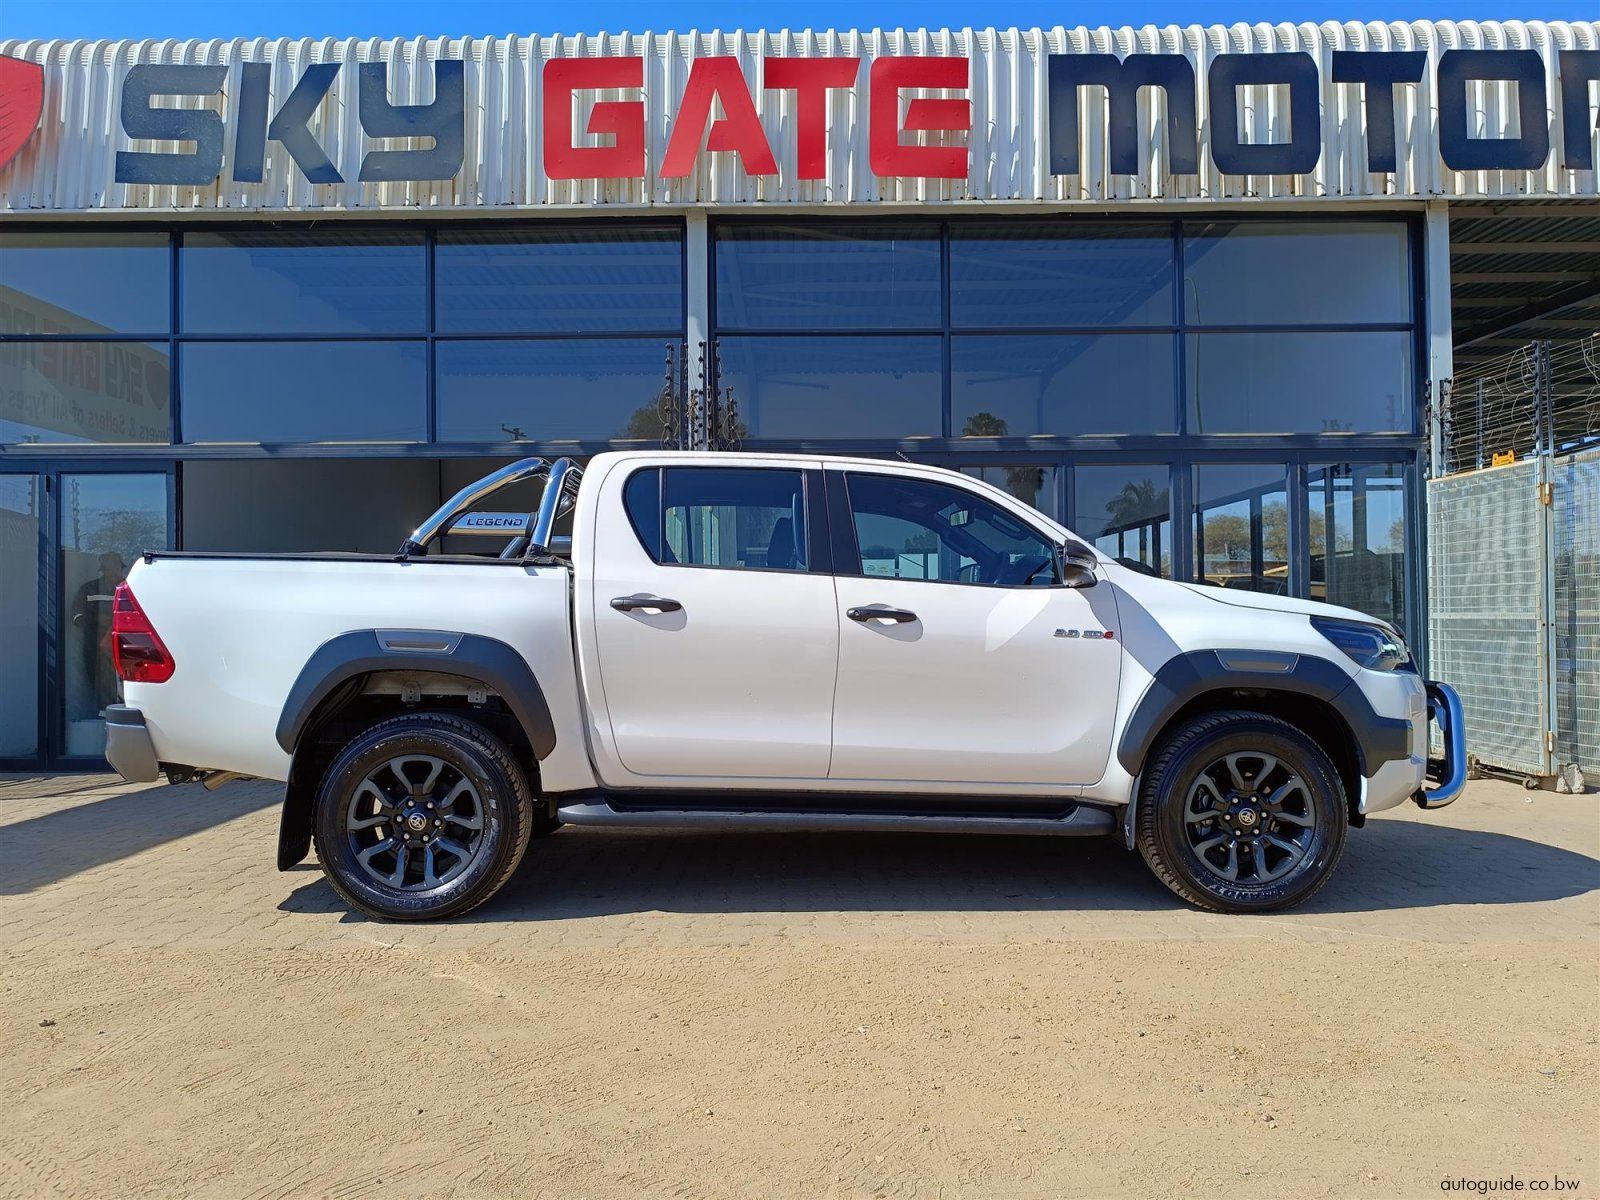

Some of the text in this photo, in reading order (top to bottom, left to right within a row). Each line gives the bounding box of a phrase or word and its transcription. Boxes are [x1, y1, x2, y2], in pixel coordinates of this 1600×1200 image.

[115, 60, 464, 186] SKY
[543, 56, 970, 180] GATE
[466, 517, 523, 527] LEGEND
